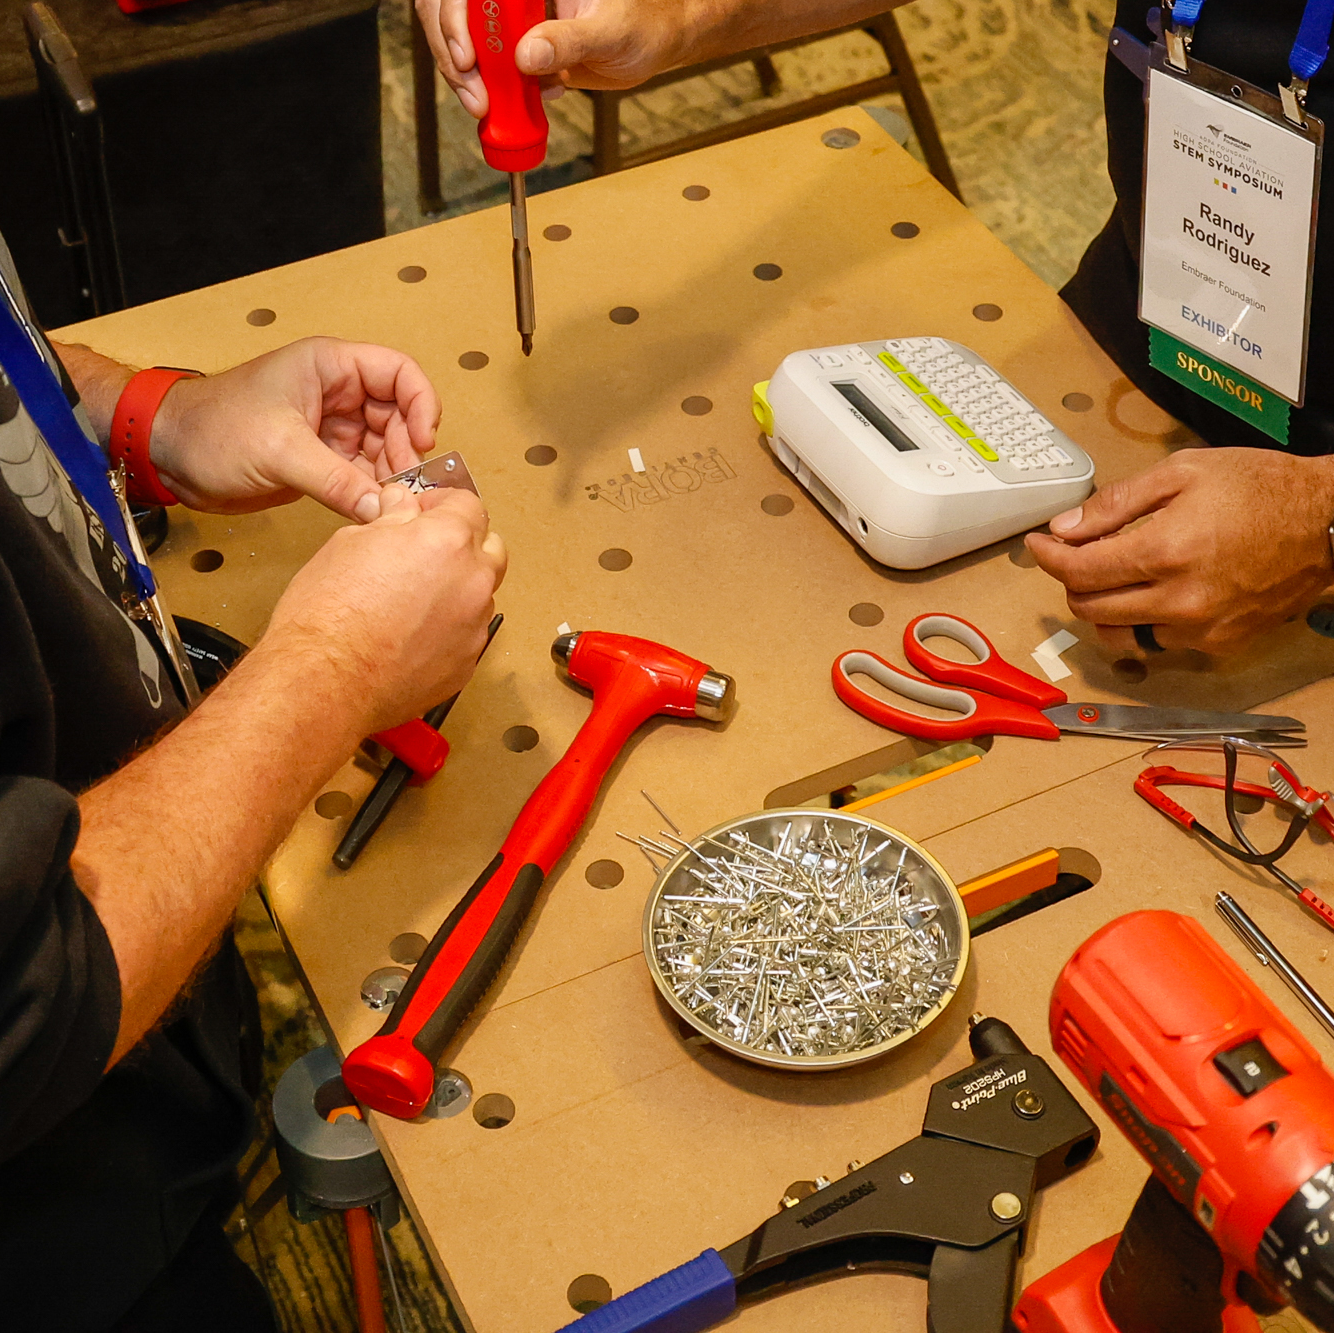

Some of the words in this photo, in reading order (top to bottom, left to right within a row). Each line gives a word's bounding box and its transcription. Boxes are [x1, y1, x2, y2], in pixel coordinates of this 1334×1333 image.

[1173, 129, 1195, 145] HIGH
[1198, 141, 1235, 166] SCHOOL
[1239, 162, 1284, 188] AVIATION
[1223, 133, 1252, 149] EMBRAER
[1173, 139, 1204, 162] STEM
[1208, 157, 1283, 200] SYMPOSIUM
[1183, 217, 1271, 277] Rodriguez
[1200, 202, 1255, 246] Randy
[1182, 260, 1217, 286] Embraer
[1218, 280, 1266, 312] Foundation
[1182, 304, 1263, 359] EXHIBITOR
[1177, 351, 1264, 411] SPONSOR
[848, 407, 870, 427] brother
[598, 453, 738, 514] BORA
[206, 652, 219, 661] WEAR
[962, 1068, 1006, 1095] HPS202
[797, 1180, 878, 1229] PROFESSIONAL
